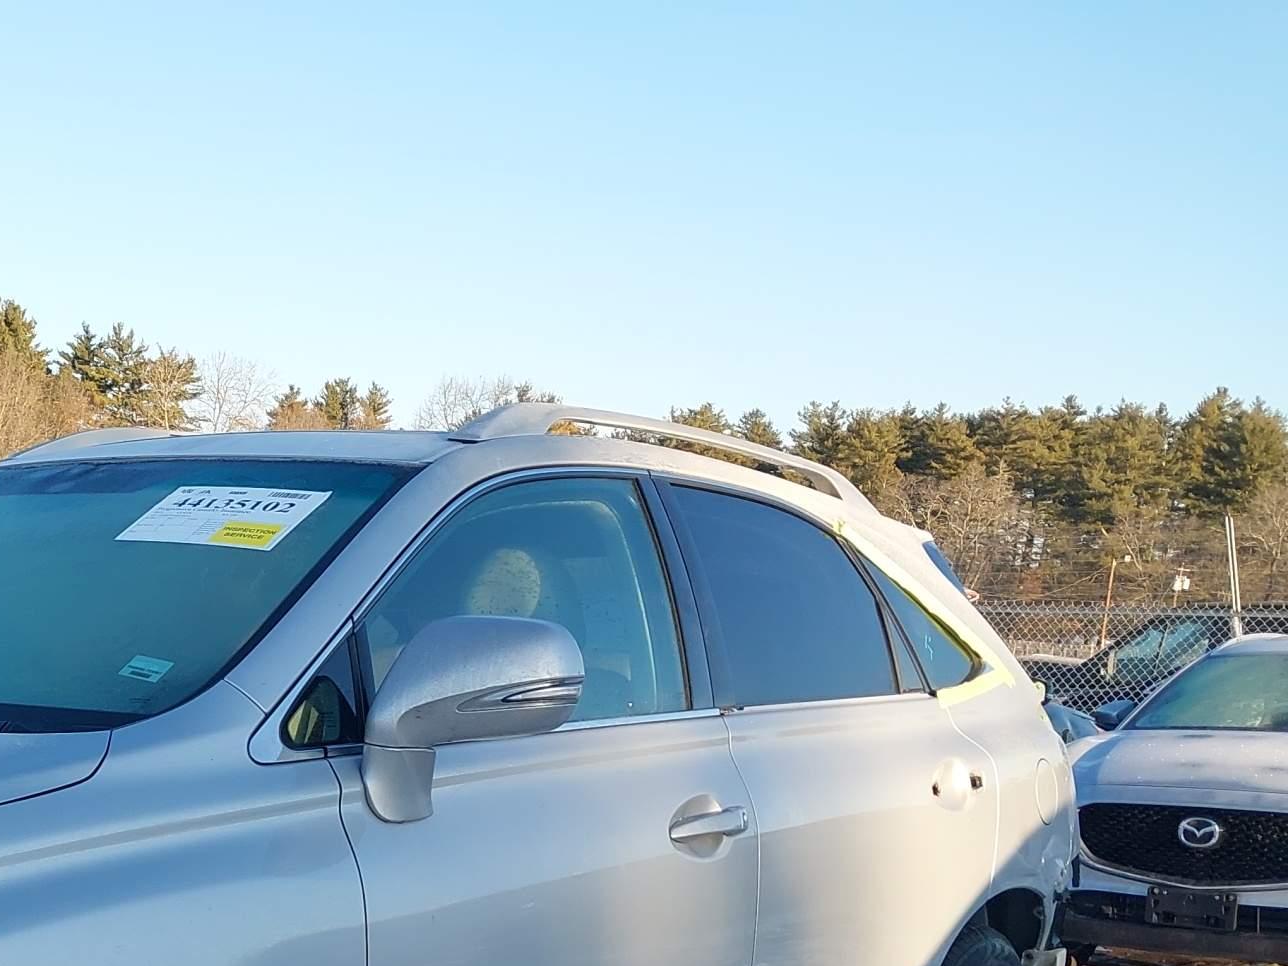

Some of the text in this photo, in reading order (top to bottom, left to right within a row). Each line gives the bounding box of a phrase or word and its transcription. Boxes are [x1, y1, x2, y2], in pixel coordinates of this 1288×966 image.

[172, 497, 297, 514] 44135102
[223, 526, 277, 535] INSPECTION
[223, 532, 264, 540] SERVICE
